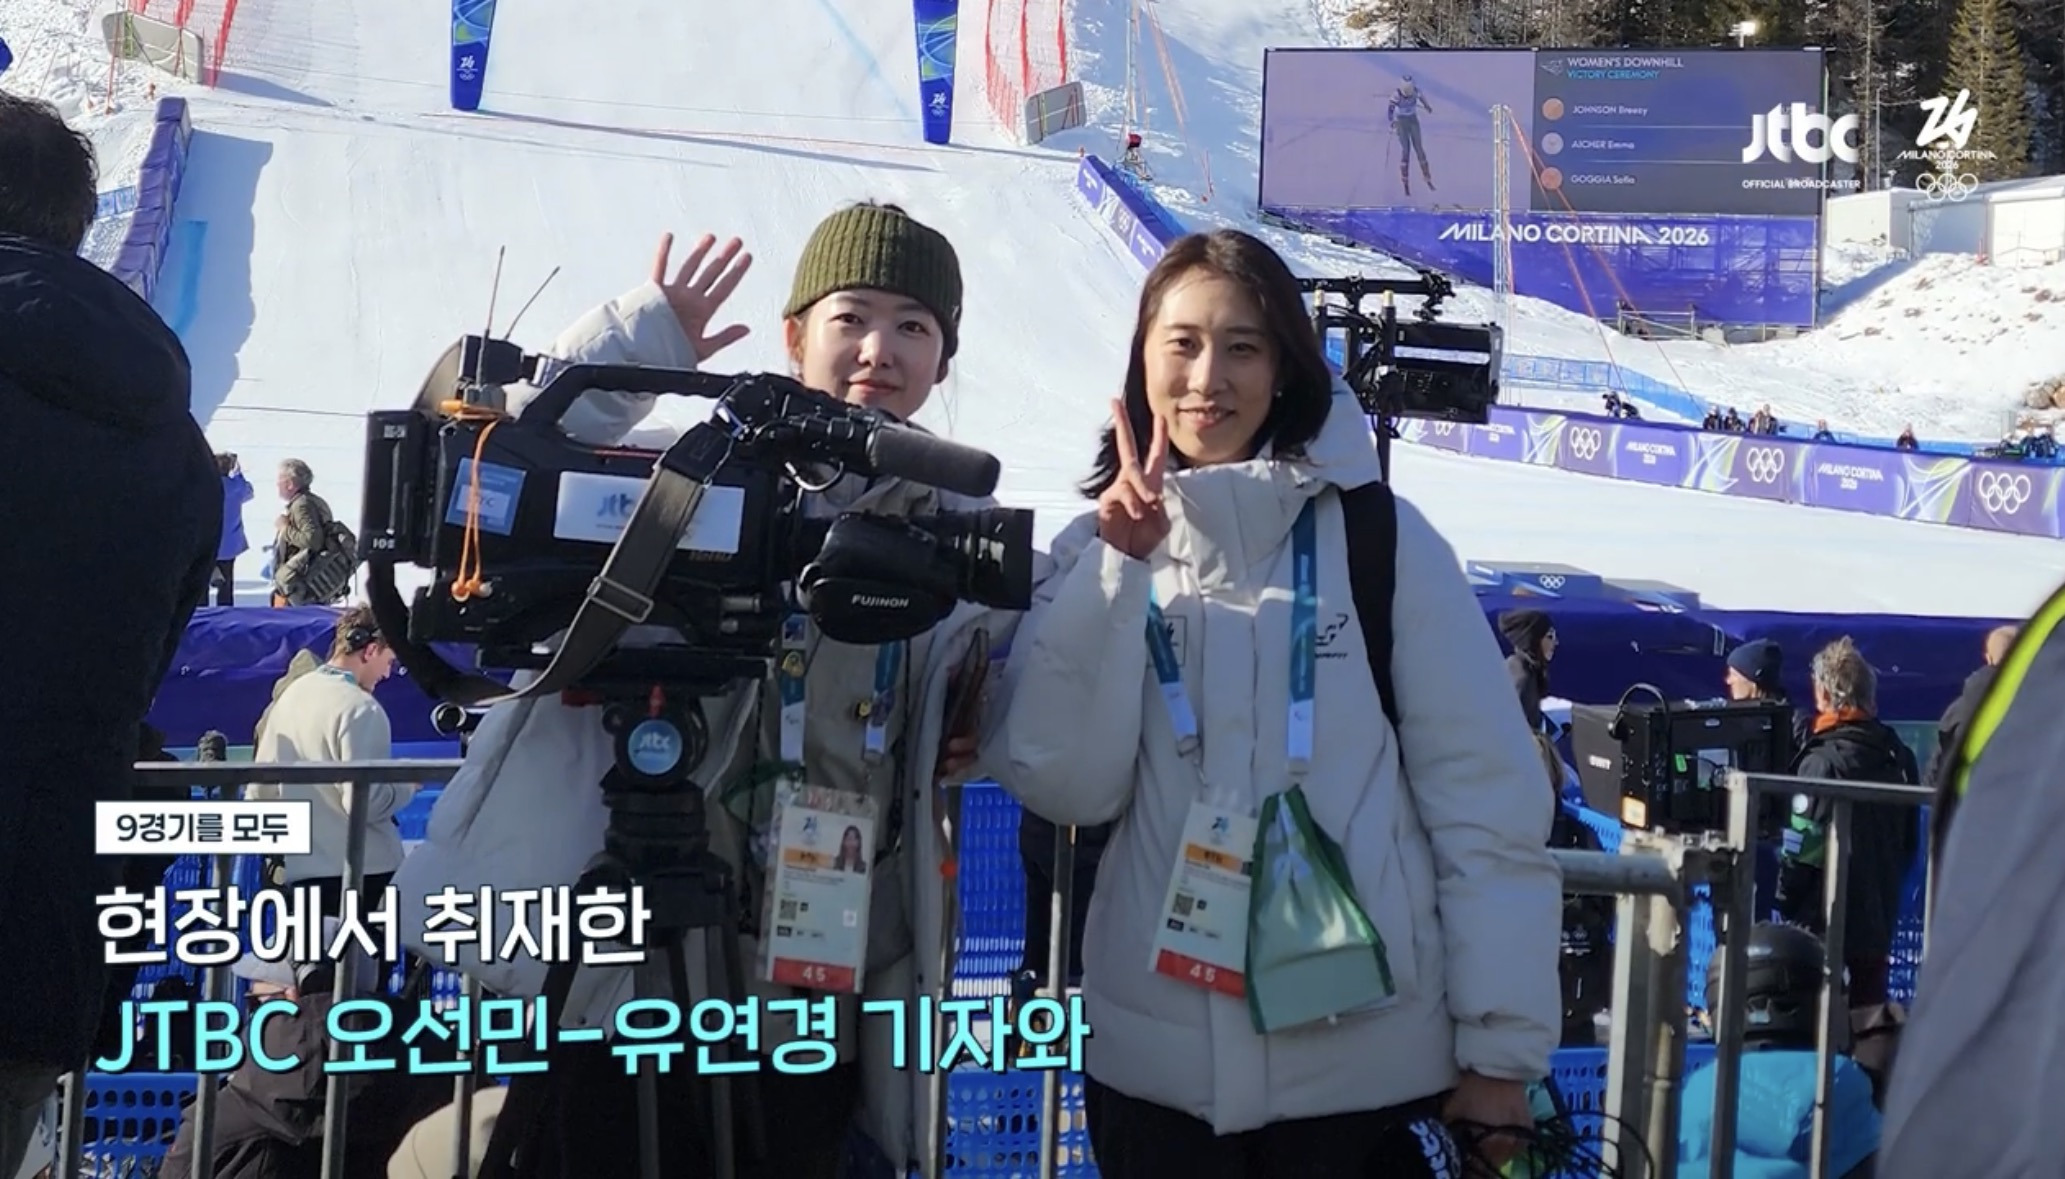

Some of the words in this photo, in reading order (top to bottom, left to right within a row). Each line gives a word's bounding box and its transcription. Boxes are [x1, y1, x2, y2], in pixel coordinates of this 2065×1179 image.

[1567, 57, 1622, 68] WOMEN'S
[1624, 57, 1684, 68] DOWNHILL
[1567, 70, 1606, 79] VICTORY
[1608, 70, 1660, 79] CEREMONY
[1573, 105, 1617, 114] JOHNSON
[1571, 140, 1607, 149] AICHER
[1608, 141, 1635, 150] Emma
[1571, 175, 1612, 184] GOGGIA
[1613, 175, 1636, 184] Sofia
[1438, 223, 1541, 242] MILANO
[1545, 224, 1653, 245] CORTINA
[1658, 226, 1710, 247] 2026
[851, 594, 909, 608] FUJINON
